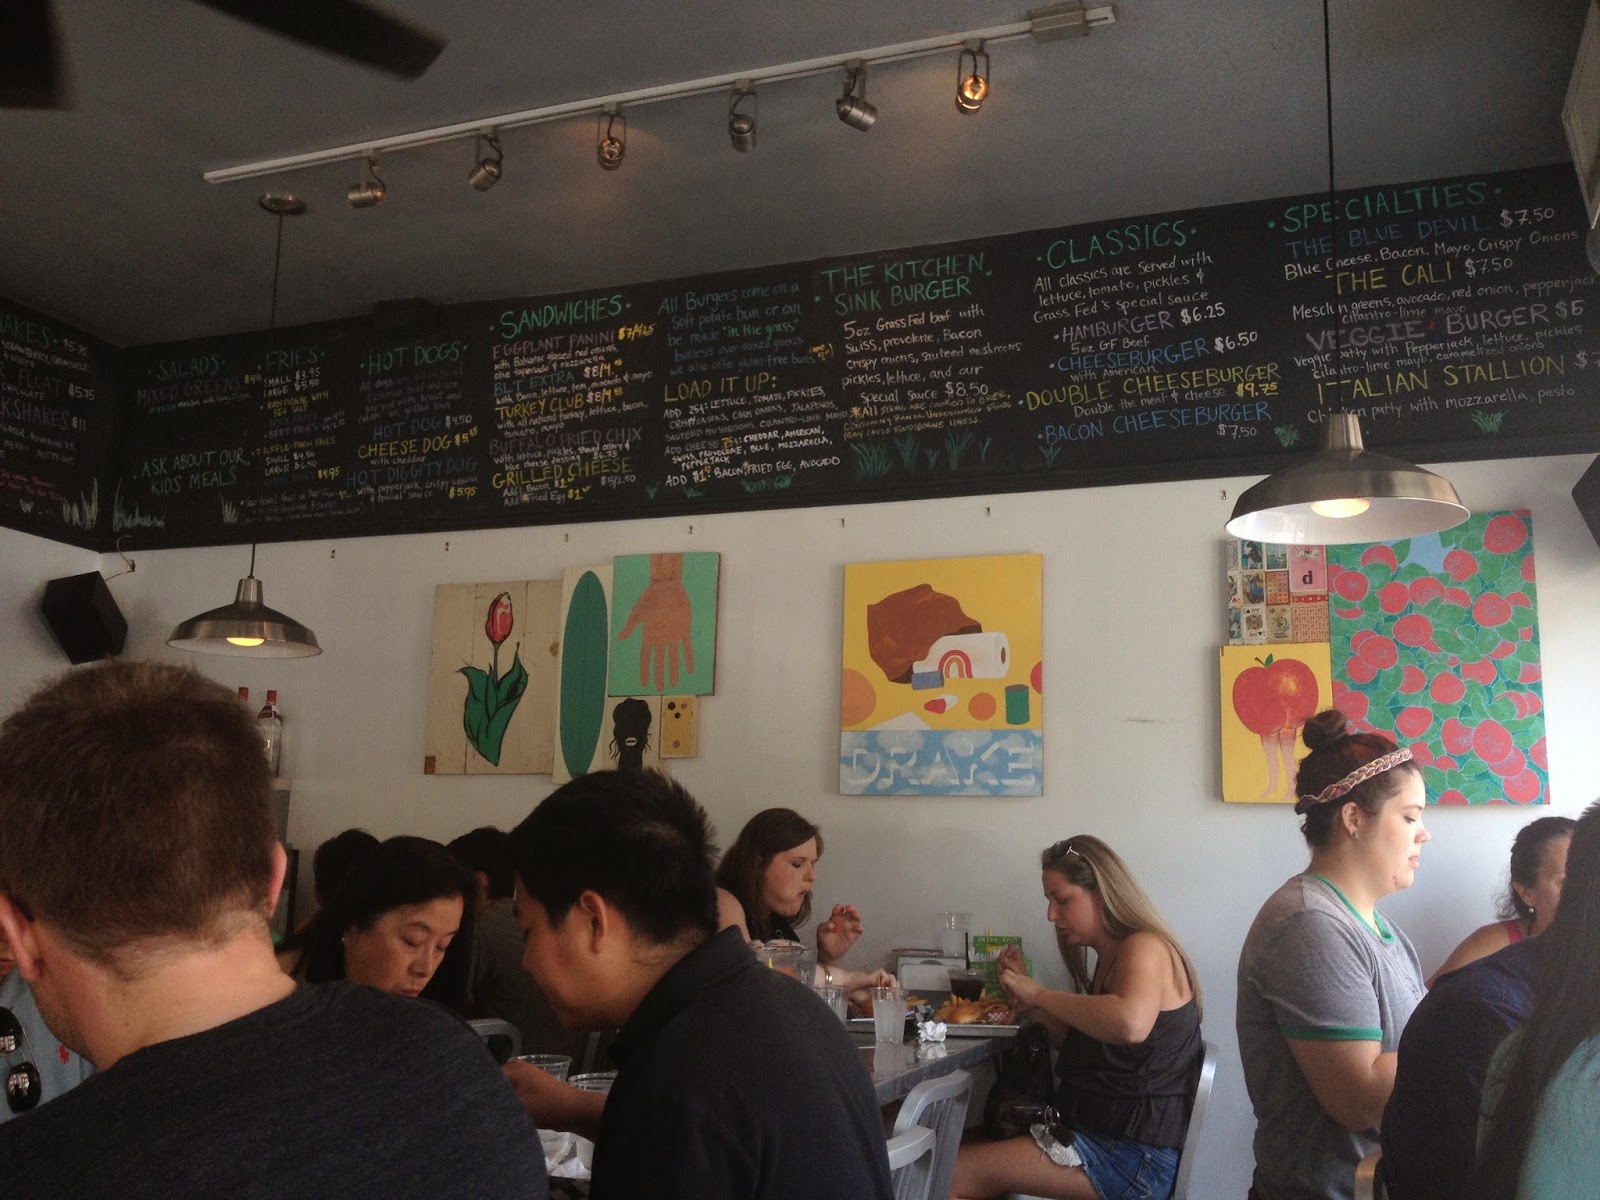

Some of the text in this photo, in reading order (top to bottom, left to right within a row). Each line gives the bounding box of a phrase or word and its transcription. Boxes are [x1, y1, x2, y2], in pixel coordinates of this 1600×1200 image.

[1283, 181, 1488, 233] SPECIALTIES
[1047, 220, 1187, 269] CLASSICS
[1284, 207, 1554, 259] THE BLUE DEVIL $7.50
[1284, 261, 1321, 280] Blue
[1478, 236, 1522, 253] Crispy
[1530, 230, 1578, 244] Onions
[821, 252, 984, 292] THE KITCHEN
[1033, 251, 1213, 293] All classics with
[1325, 258, 1513, 295] THE CALI $7.50
[657, 296, 678, 315] All
[686, 289, 738, 312] Burgers
[835, 276, 973, 316] SINK BURGER
[1039, 274, 1190, 306] lettuce, tomato, pickles
[1397, 291, 1451, 307] avocado,
[1452, 287, 1472, 299] red
[1477, 283, 1519, 297] onion,
[500, 295, 622, 338] SANDWICHES
[766, 305, 777, 316] or
[929, 309, 952, 324] beef
[960, 303, 985, 318] with
[1033, 290, 1209, 324] Grass special sauce
[1435, 305, 1467, 317] mayo
[943, 328, 982, 339] Bacon
[1062, 302, 1226, 344] HAMBURGER $6.25
[1306, 303, 1550, 352] VEGGIE BURGER
[266, 346, 319, 369] FRIES
[369, 340, 460, 374] HOT DOGS
[492, 330, 615, 360] EGGPLANT PANINI
[846, 342, 1022, 371] crispy onions, sauteed mushrooms
[1057, 331, 1258, 373] CHEESEBURGER $6.50
[1071, 335, 1150, 356] 5oz GF Beef
[1294, 353, 1332, 372] Veggie
[1372, 342, 1399, 356] with
[1536, 325, 1583, 340] pickles
[1509, 340, 1545, 354] onions
[156, 353, 219, 380] SALADS
[842, 365, 984, 390] pickles, lettuce, and our
[1070, 365, 1158, 383] with American
[1317, 354, 1565, 405] ITALIAN STALLION
[137, 383, 179, 406] MIXED
[184, 378, 241, 397] GREENS
[494, 370, 575, 397] BLT EXTRA
[664, 372, 777, 402] LOAD IT UP:
[945, 382, 988, 398] $8.50
[1026, 362, 1282, 411] DOUBLE CHEESEBURGER
[495, 399, 547, 420] TURKEY
[550, 394, 584, 412] CLUB
[664, 408, 682, 419] ADD
[1073, 402, 1115, 419] Double
[1118, 398, 1136, 408] the
[1140, 395, 1167, 406] meat
[1184, 388, 1227, 401] cheese
[1372, 384, 1575, 418] patty with pesto
[373, 417, 442, 441] HOT DOG
[1045, 401, 1273, 443] BACON CHEESEBURGER
[1217, 424, 1257, 440] $7.50
[358, 435, 451, 459] CHEESE DOG
[489, 427, 643, 455] BUFFALO FRIED CHIX
[141, 448, 245, 478] ASK ABOUT OUR
[347, 469, 382, 488] HOT
[446, 456, 480, 474] DOG
[493, 457, 632, 489] GRILLED CHEESE
[665, 475, 687, 487] ADD
[800, 456, 840, 470] AVOCADO
[151, 466, 237, 495] KIDS MEALS
[1302, 571, 1313, 585] d
